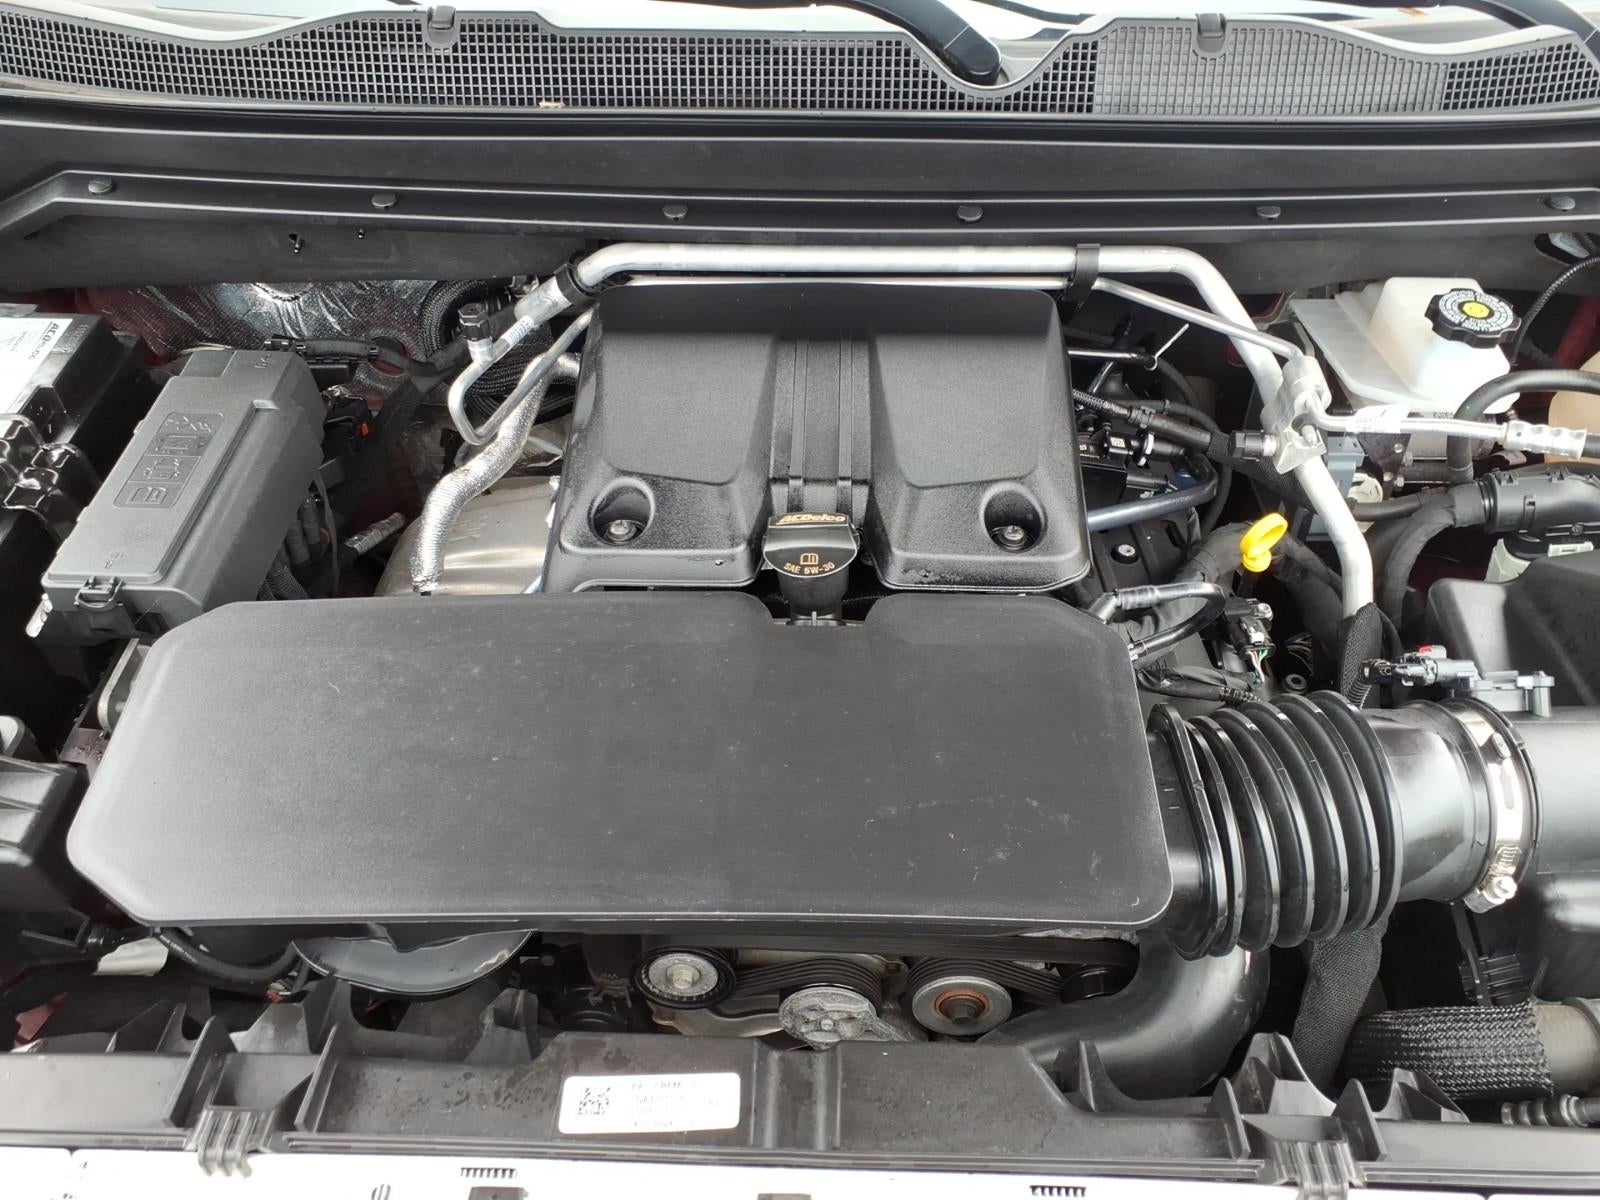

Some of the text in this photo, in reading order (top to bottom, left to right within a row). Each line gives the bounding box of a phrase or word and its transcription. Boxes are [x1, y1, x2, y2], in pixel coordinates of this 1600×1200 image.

[778, 514, 846, 523] ACDelco
[784, 563, 835, 574] SAE 5W-30
